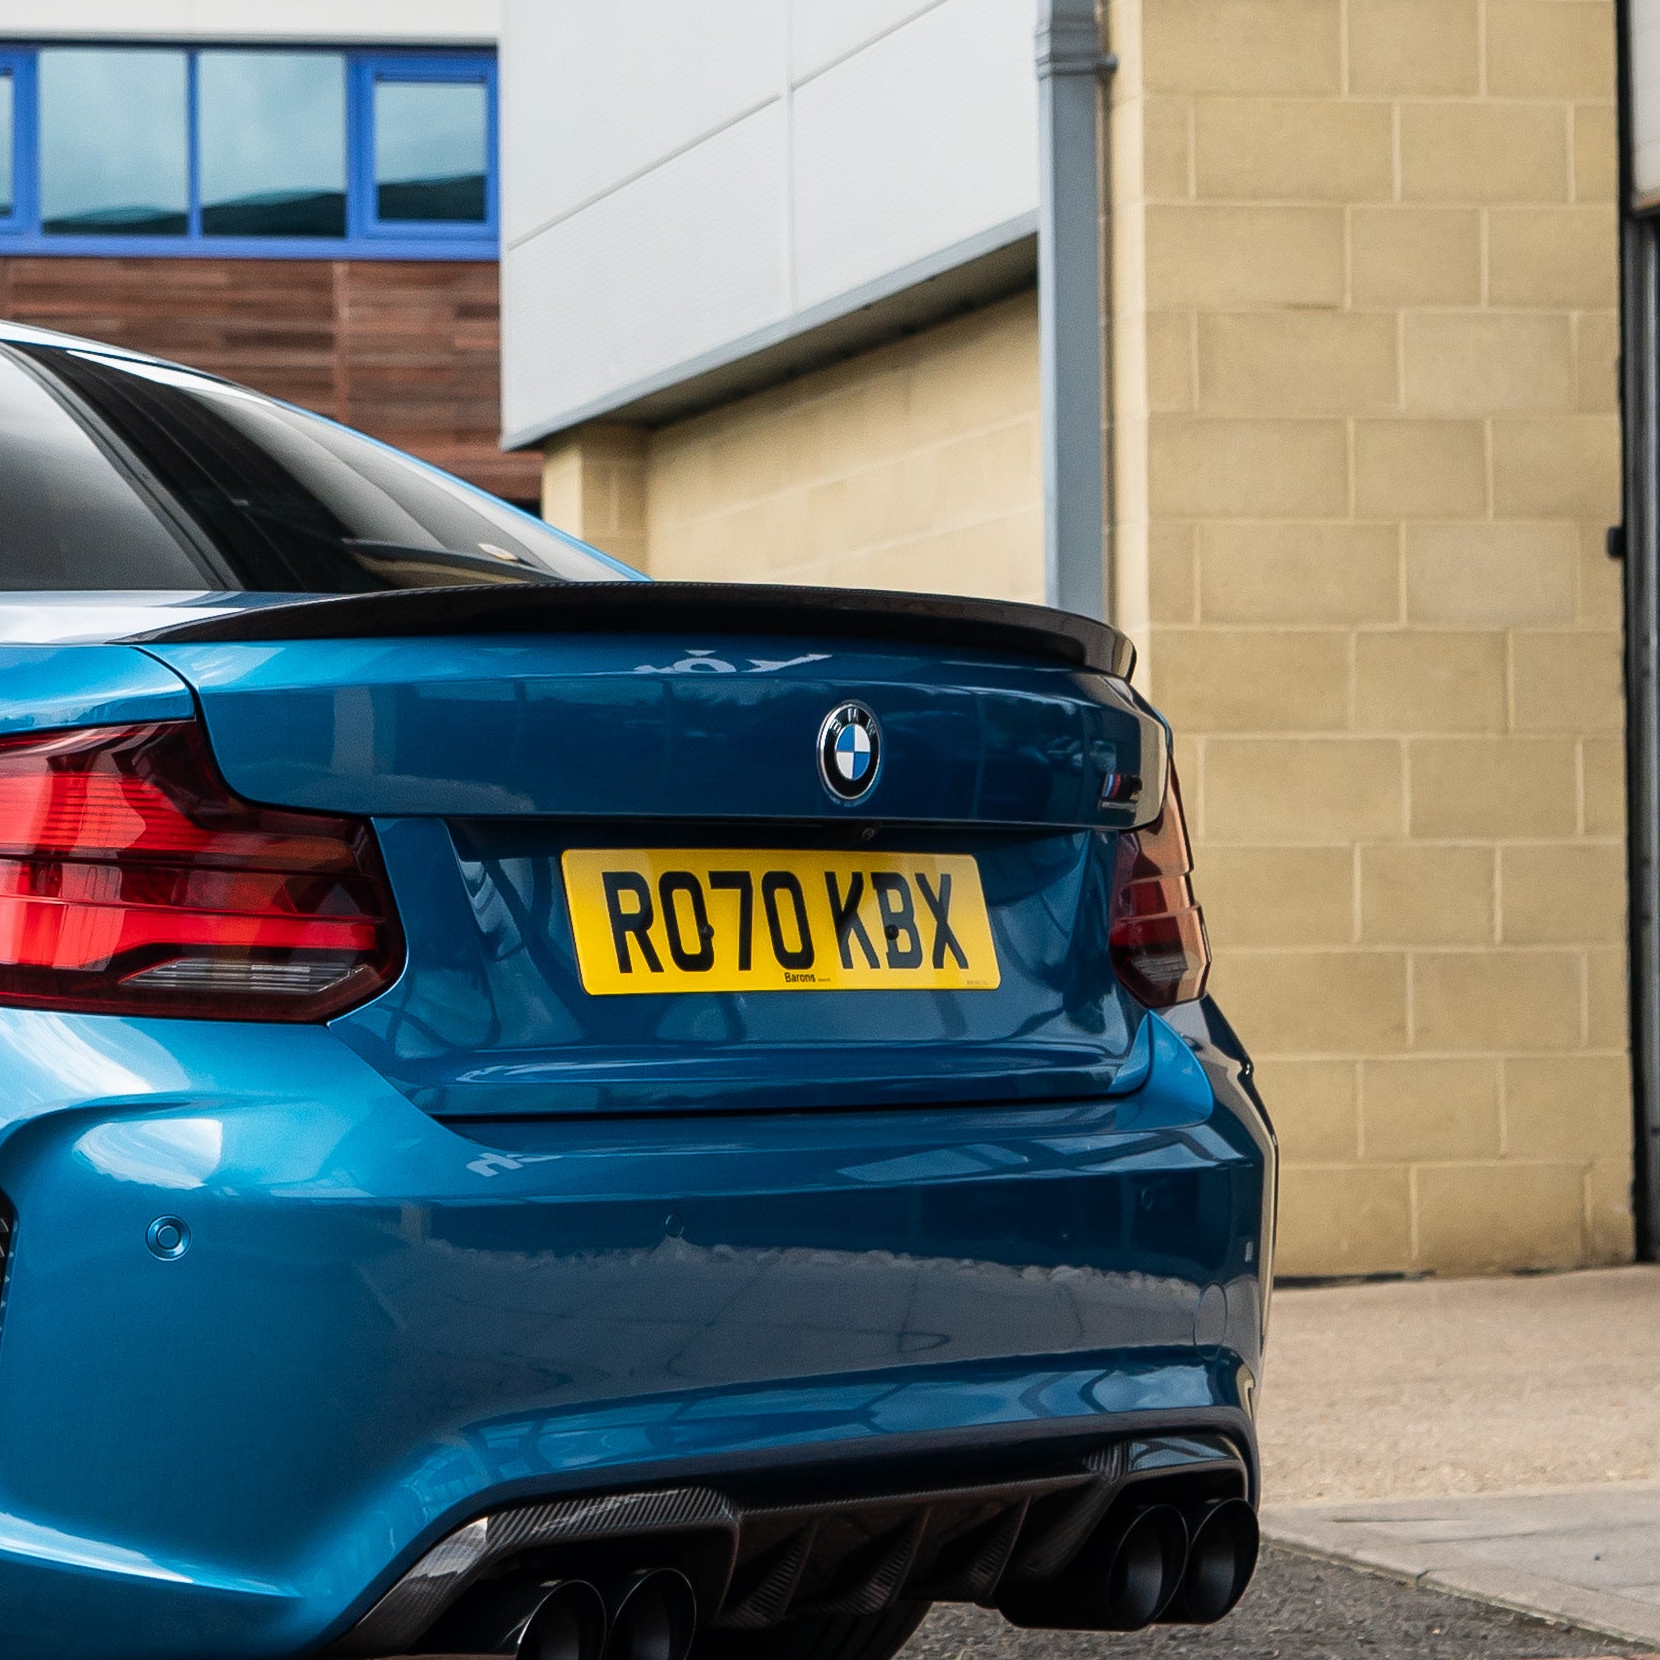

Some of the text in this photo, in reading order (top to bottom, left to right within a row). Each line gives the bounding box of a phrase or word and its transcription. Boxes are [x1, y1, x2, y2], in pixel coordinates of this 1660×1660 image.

[829, 707, 876, 739] BMW
[601, 870, 970, 974] RO70 KBX
[784, 972, 816, 983] Barons
